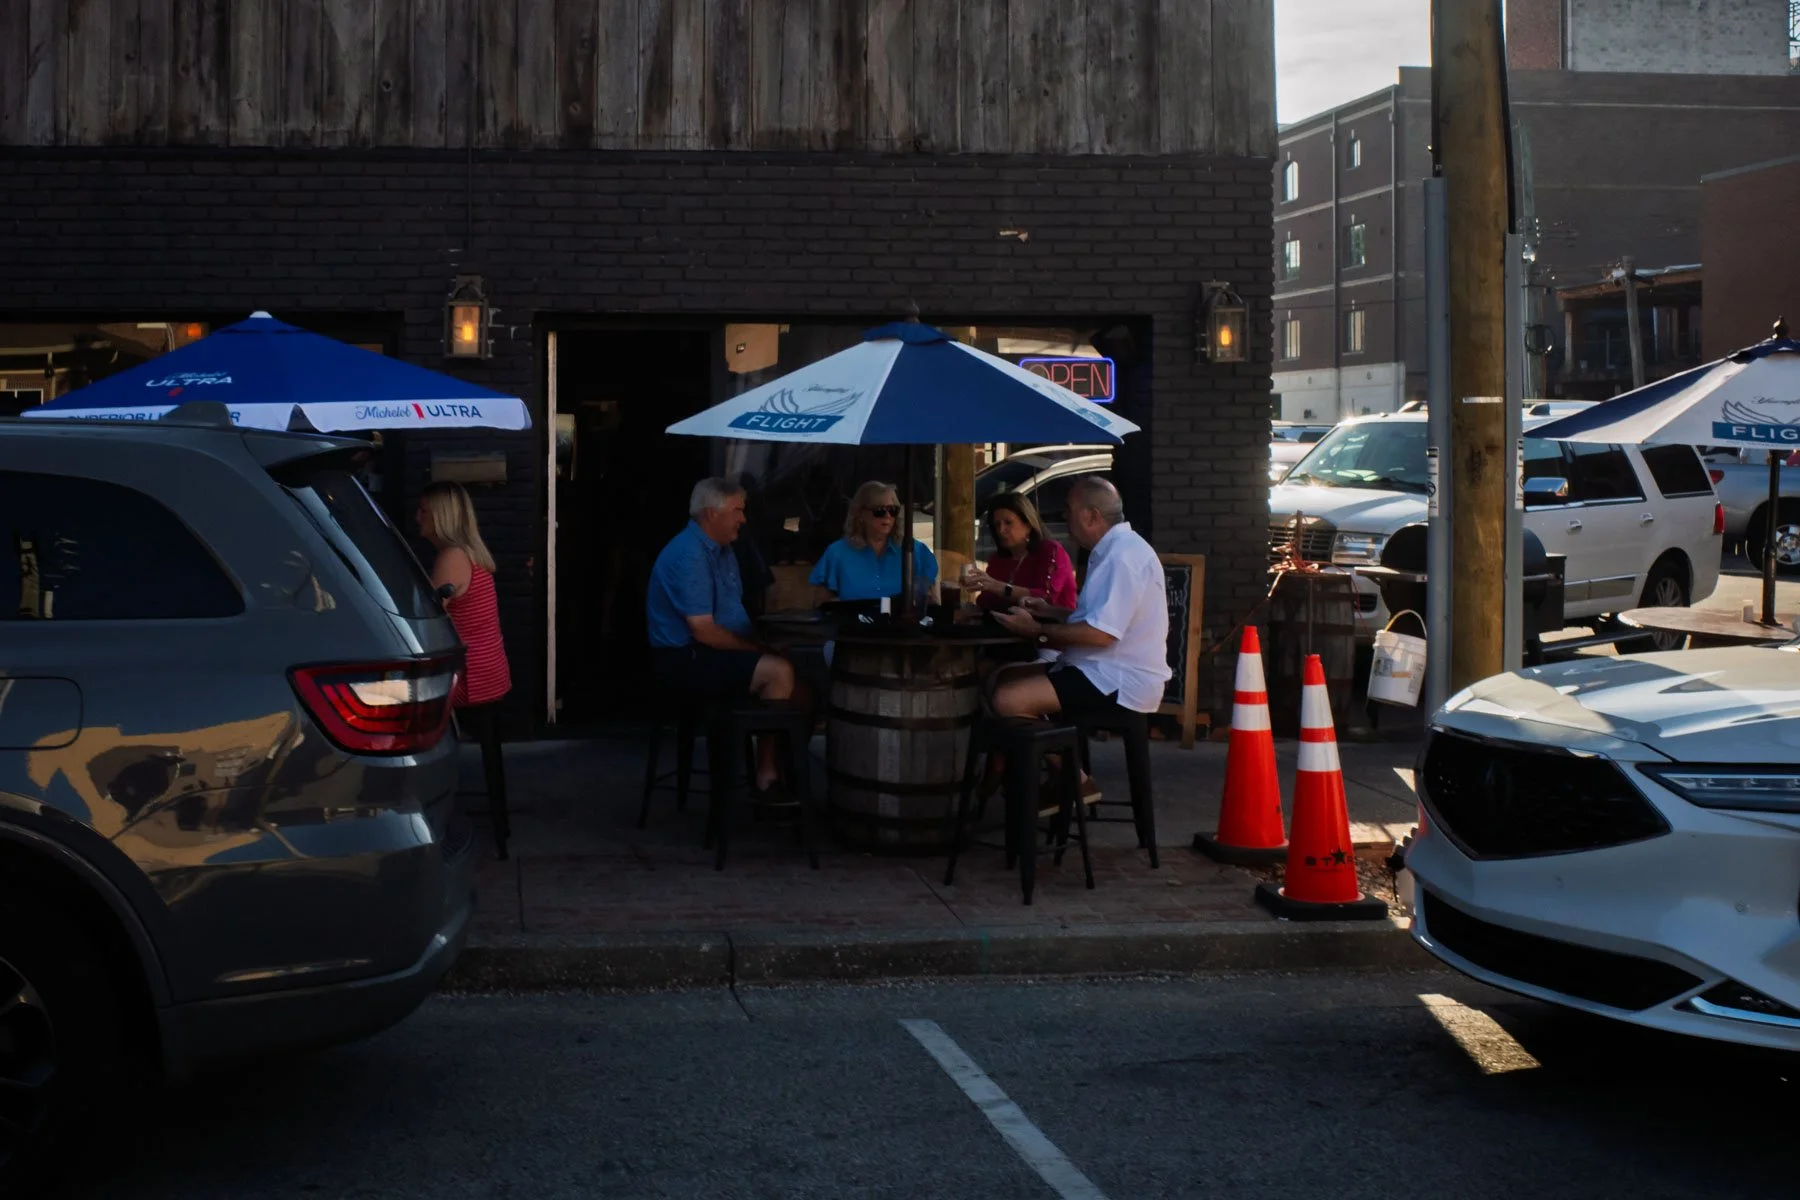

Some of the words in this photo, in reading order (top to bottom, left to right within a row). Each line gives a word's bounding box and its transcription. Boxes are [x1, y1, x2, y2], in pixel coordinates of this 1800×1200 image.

[146, 376, 232, 386] ULTRA
[426, 404, 482, 418] ULTRA
[746, 415, 827, 430] FLIGHT
